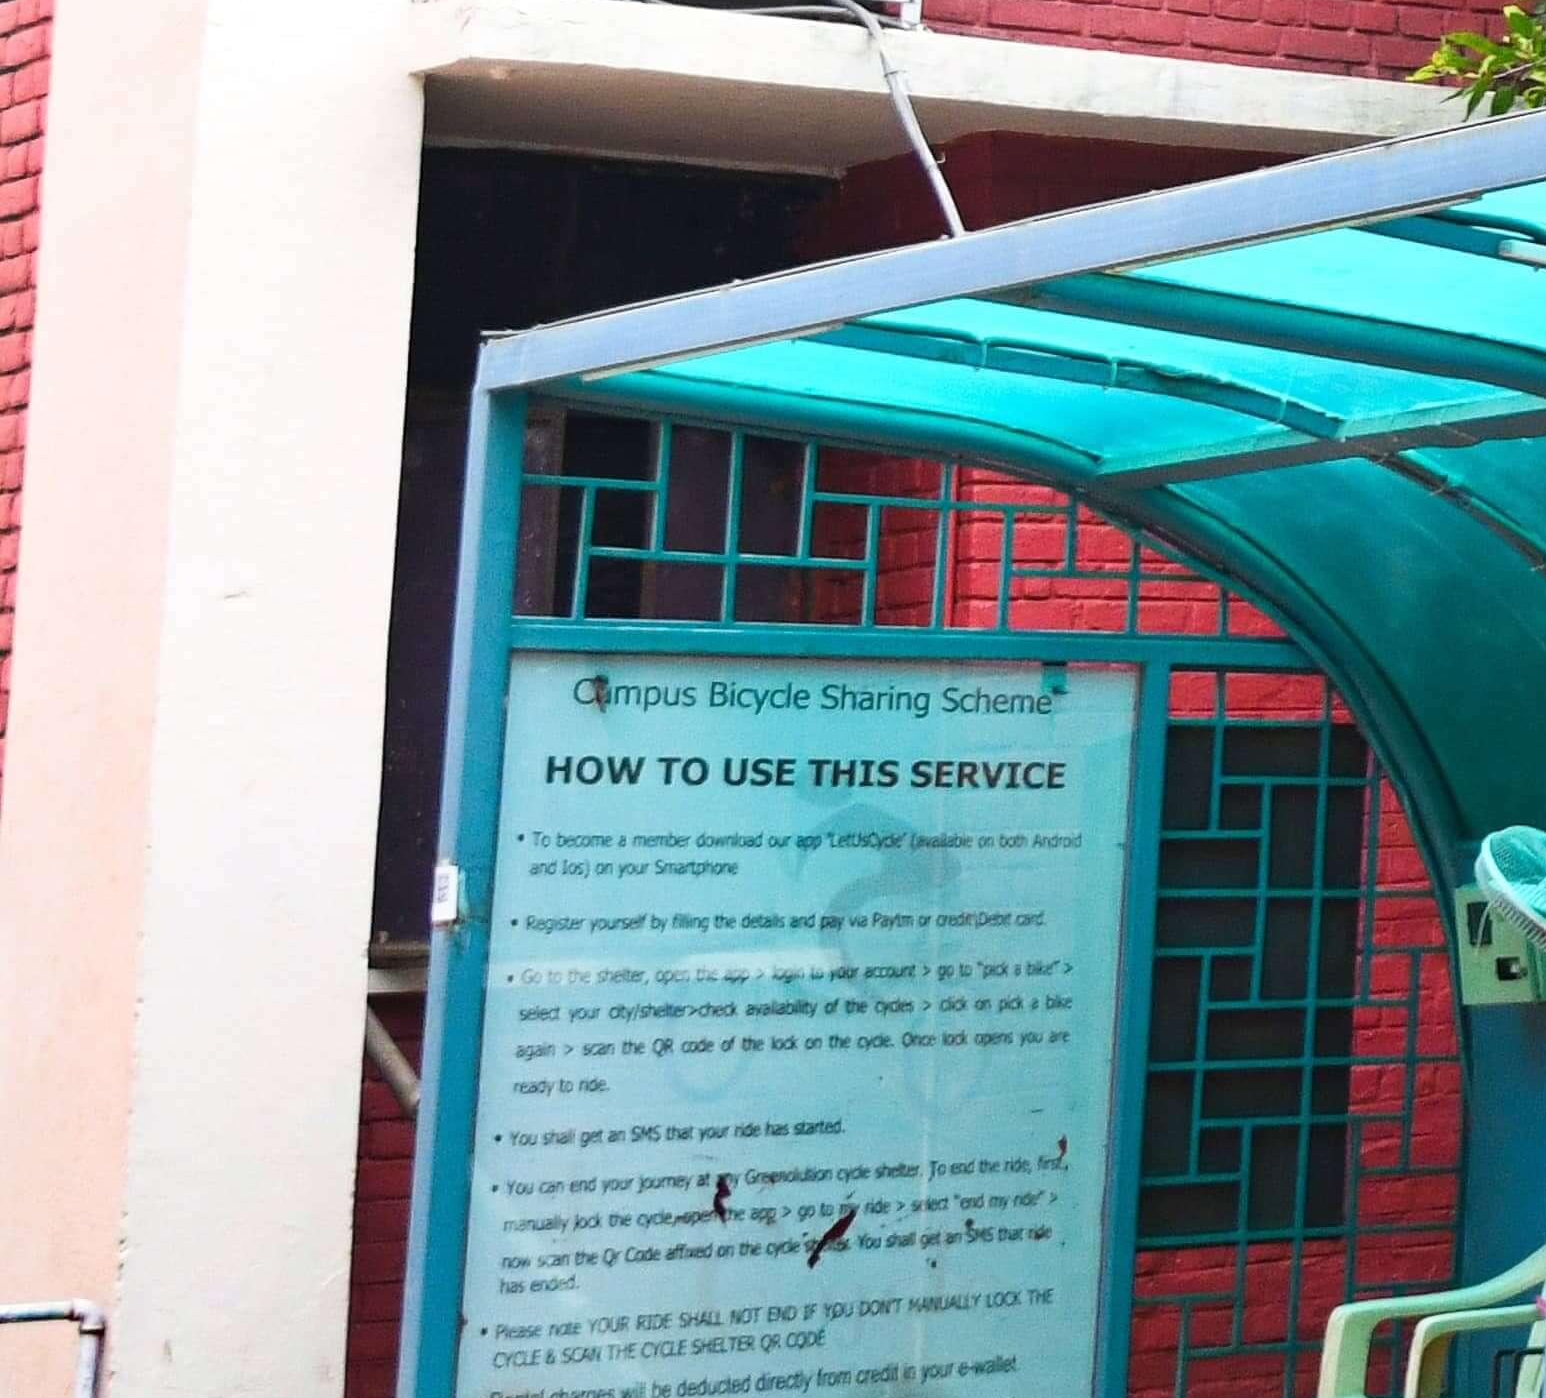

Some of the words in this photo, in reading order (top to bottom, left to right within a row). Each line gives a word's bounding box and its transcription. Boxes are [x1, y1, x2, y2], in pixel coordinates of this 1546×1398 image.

[709, 681, 810, 714] Bicycle
[821, 684, 930, 718] Sharing
[545, 755, 646, 785] HOW
[657, 756, 710, 786] TO
[723, 758, 797, 786] USE
[808, 758, 899, 788] THIS
[911, 760, 1066, 789] SERVICE
[532, 830, 550, 848] To
[556, 831, 612, 848] become
[632, 832, 691, 848] member
[696, 831, 763, 848] download
[768, 835, 790, 848] our
[795, 835, 822, 852] app
[978, 835, 995, 848] on
[1032, 832, 1082, 850] Android
[529, 859, 557, 876] and
[595, 862, 613, 875] on
[618, 861, 649, 879] your
[654, 859, 738, 878] Smartphone
[526, 914, 584, 935] Register
[590, 913, 646, 933] yourself
[651, 913, 668, 933] by
[672, 913, 710, 933] filling
[715, 913, 735, 930] the
[741, 913, 785, 930] details
[790, 913, 815, 929] and
[820, 915, 846, 932] pay
[850, 914, 869, 928] via
[872, 912, 914, 930] Paytm
[918, 915, 932, 928] or
[515, 1044, 555, 1060] again
[583, 1041, 615, 1056] scan
[622, 1040, 645, 1055] the
[652, 1038, 674, 1057] QR
[680, 1037, 714, 1053] code
[721, 1035, 737, 1052] of
[741, 1036, 765, 1052] the
[771, 1035, 798, 1051] lock
[804, 1037, 822, 1050] on
[828, 1033, 851, 1049] the
[902, 1031, 937, 1048] Once
[974, 1031, 1014, 1047] opens
[1020, 1032, 1043, 1047] you
[1048, 1031, 1070, 1043] are
[514, 1078, 555, 1095] ready
[559, 1078, 573, 1093] to
[510, 1130, 538, 1147] You
[542, 1128, 576, 1145] shall
[580, 1128, 604, 1148] get
[607, 1129, 626, 1143] an
[631, 1125, 662, 1142] SMS
[665, 1123, 694, 1140] that
[699, 1126, 730, 1142] your
[734, 1122, 762, 1138] ride
[765, 1121, 790, 1136] has
[793, 1119, 846, 1136] started.
[500, 1277, 525, 1294] has
[530, 1274, 580, 1292] ended.
[651, 1379, 671, 1398] be
[677, 1374, 752, 1396] deducted
[755, 1369, 813, 1393] directly
[817, 1367, 852, 1386] from
[856, 1362, 899, 1383] credit
[903, 1363, 917, 1380] in
[920, 1360, 955, 1383] your
